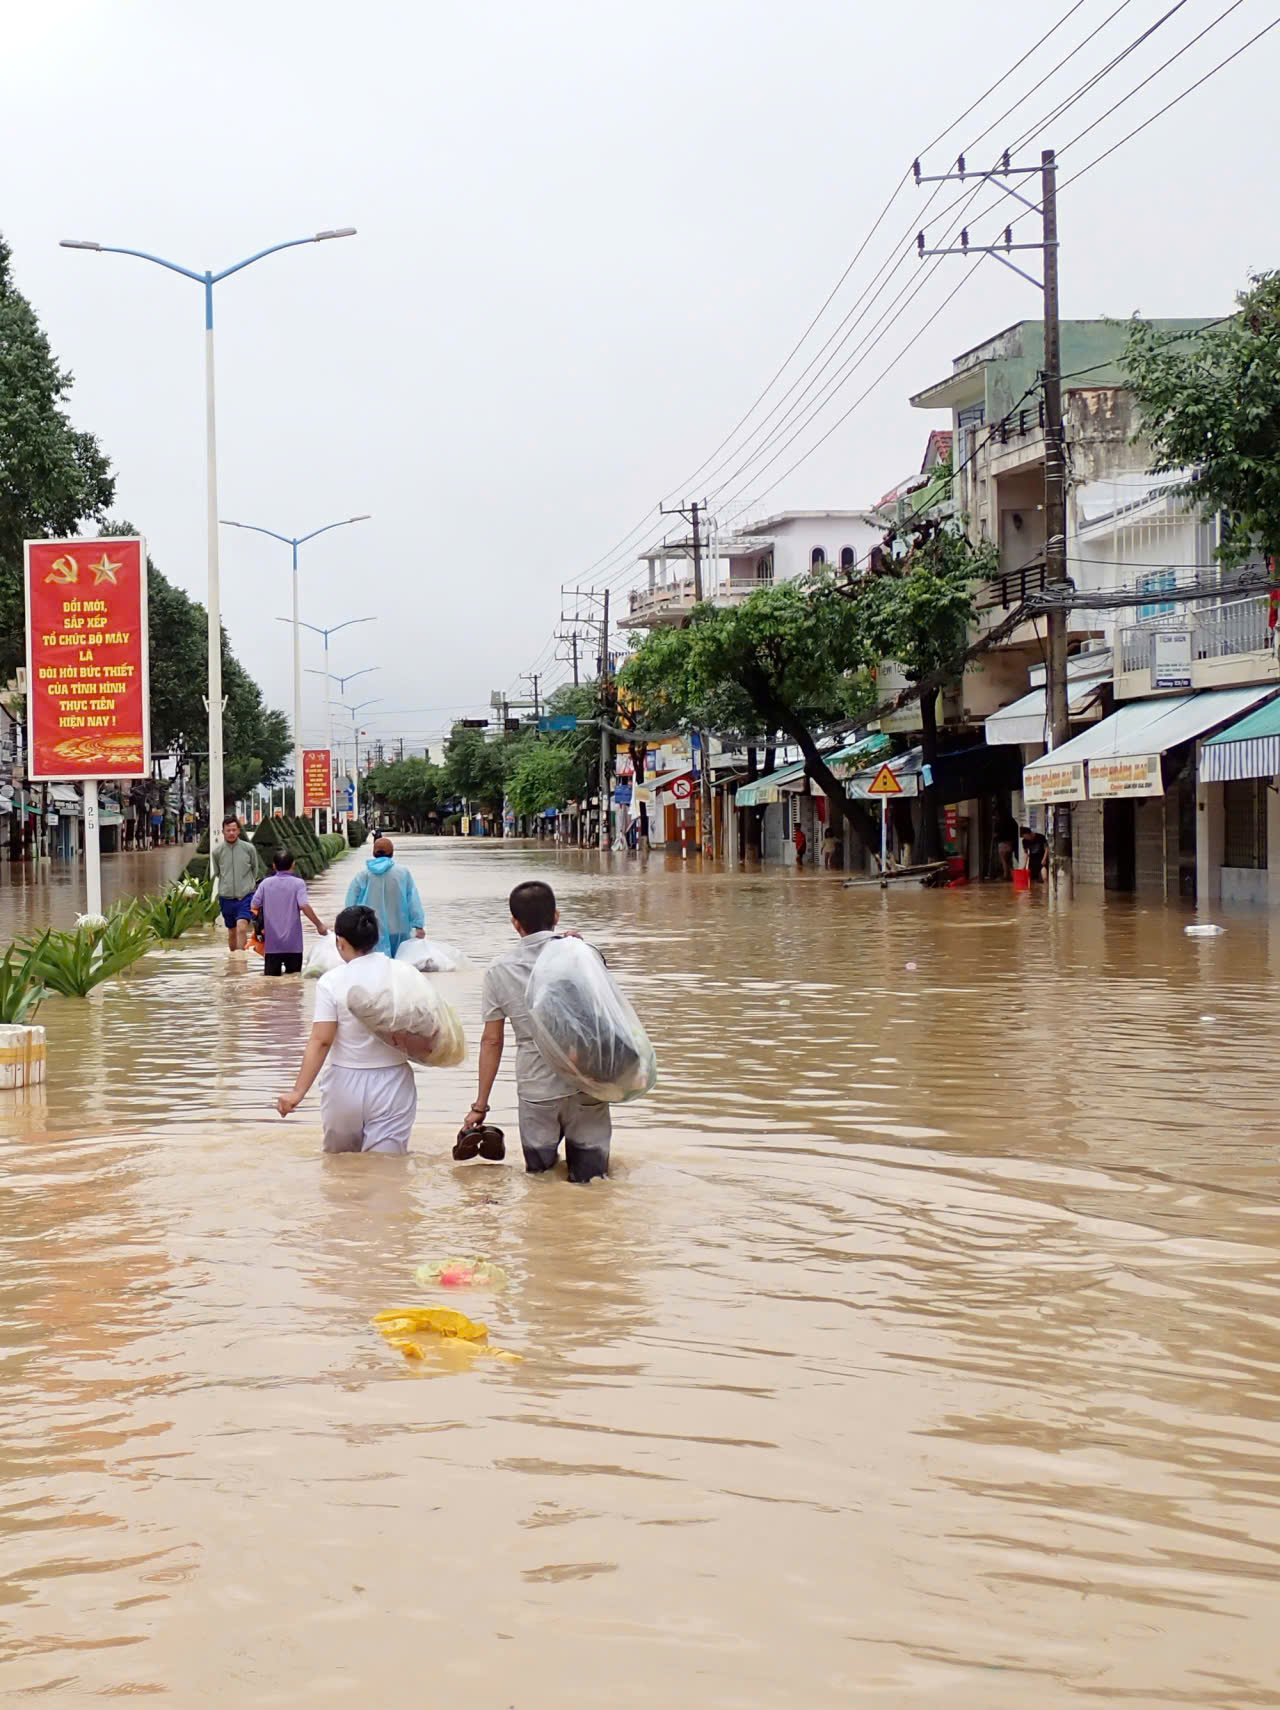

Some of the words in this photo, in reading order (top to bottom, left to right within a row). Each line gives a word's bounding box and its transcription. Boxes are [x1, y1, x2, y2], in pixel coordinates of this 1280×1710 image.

[63, 598, 81, 612] ĐỔI
[84, 599, 108, 613] MỚI,
[63, 614, 84, 629] SẮP
[87, 613, 108, 628] XẾP
[42, 631, 56, 646] TỔ
[59, 632, 86, 645] CHỨC
[88, 632, 103, 647] BỘ
[105, 631, 130, 644] MÁY
[79, 649, 93, 661] LÀ
[39, 666, 57, 679] ĐÒI
[59, 665, 78, 678] HỎI
[79, 665, 101, 678] BỨC
[103, 663, 135, 677] THIẾT
[48, 682, 69, 695] CỦA
[71, 682, 97, 695] TÌNH
[99, 681, 126, 694] HÌNH
[59, 699, 88, 712] THỰC
[59, 715, 85, 729] HIỆN
[87, 716, 110, 727] NAY
